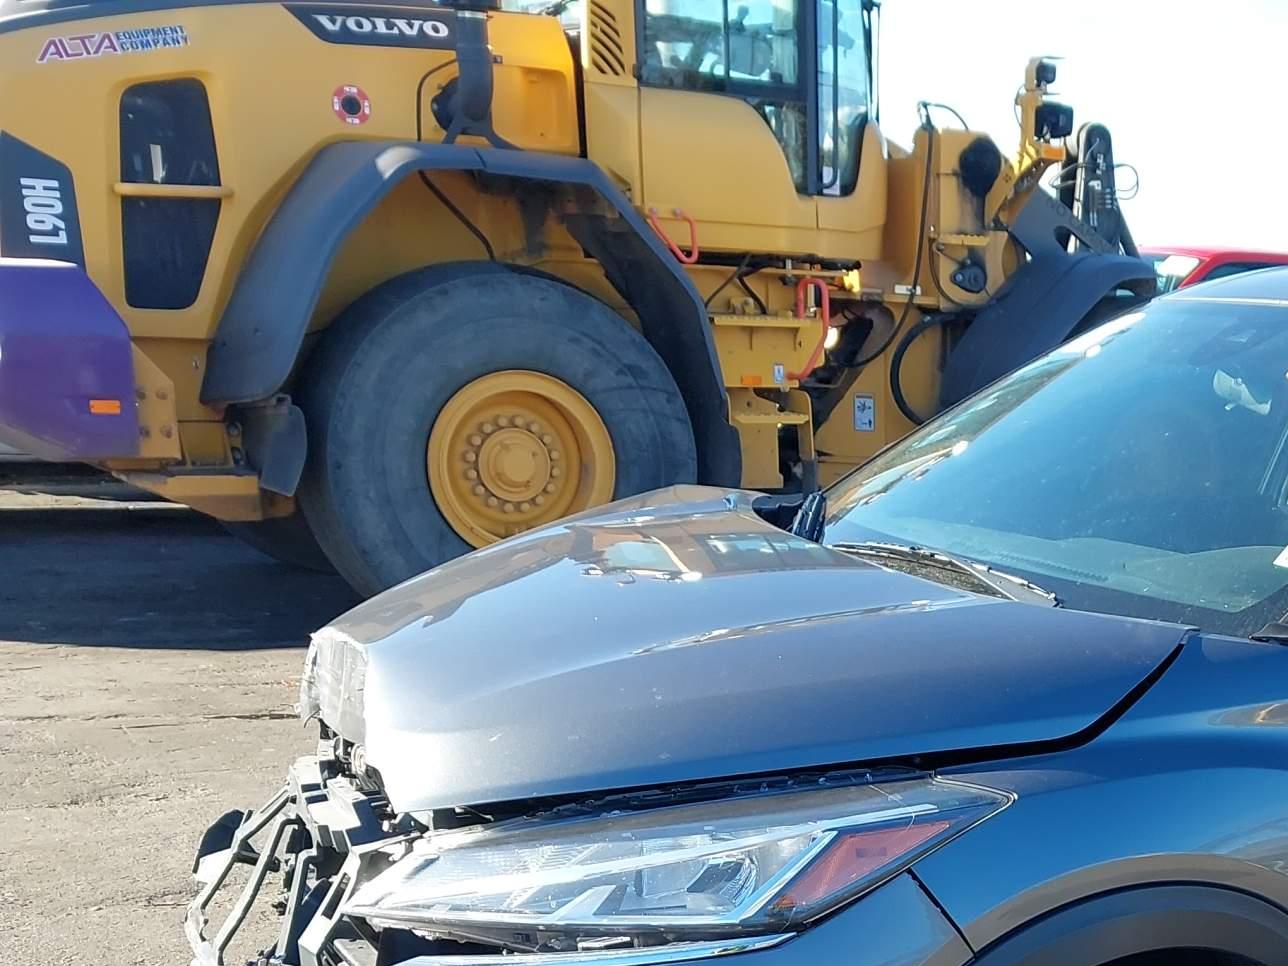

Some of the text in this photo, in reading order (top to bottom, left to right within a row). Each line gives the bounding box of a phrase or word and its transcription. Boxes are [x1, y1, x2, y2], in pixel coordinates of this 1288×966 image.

[115, 24, 186, 41] EQUIPMENT
[312, 14, 449, 37] VOLVO
[37, 32, 119, 62] ALTA
[119, 34, 190, 51] COMPANY
[20, 177, 68, 244] L90H
